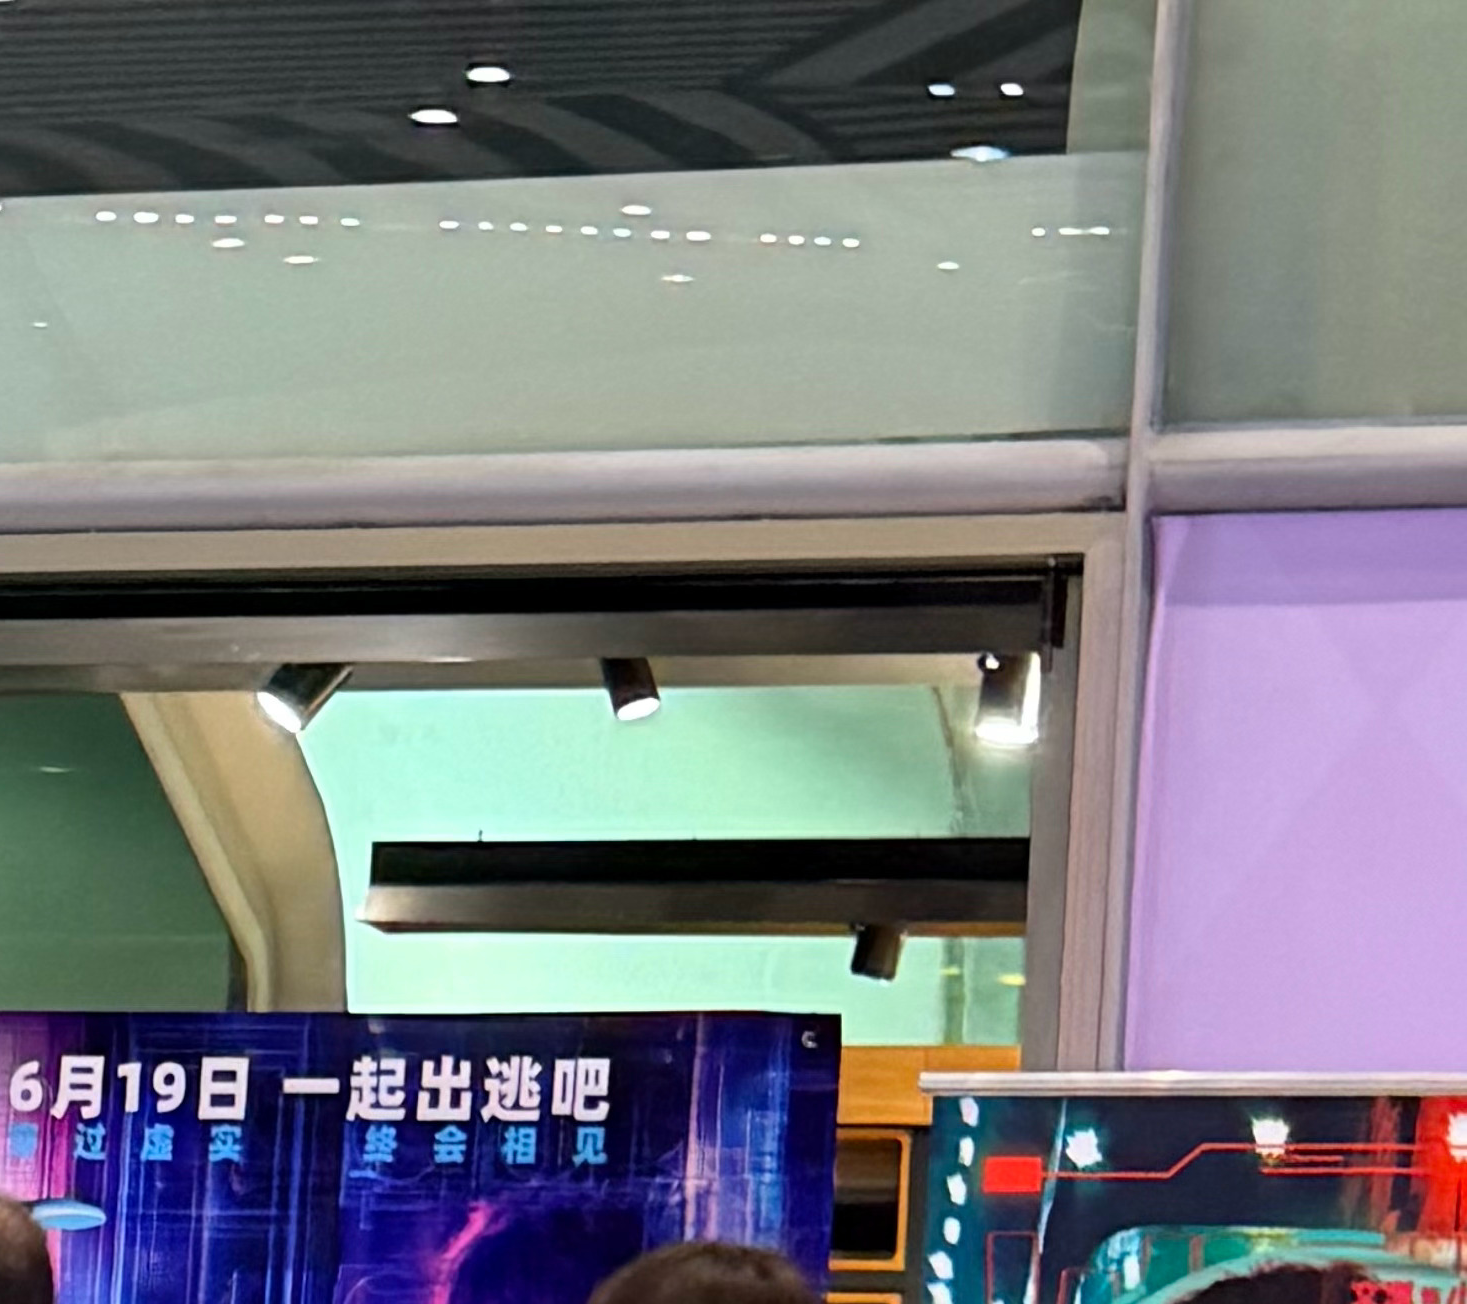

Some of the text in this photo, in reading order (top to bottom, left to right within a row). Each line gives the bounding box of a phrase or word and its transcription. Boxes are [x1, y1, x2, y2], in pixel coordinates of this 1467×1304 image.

[9, 1055, 612, 1122] 6月19日 一起出逃吧
[362, 1126, 609, 1164] 终会相见
